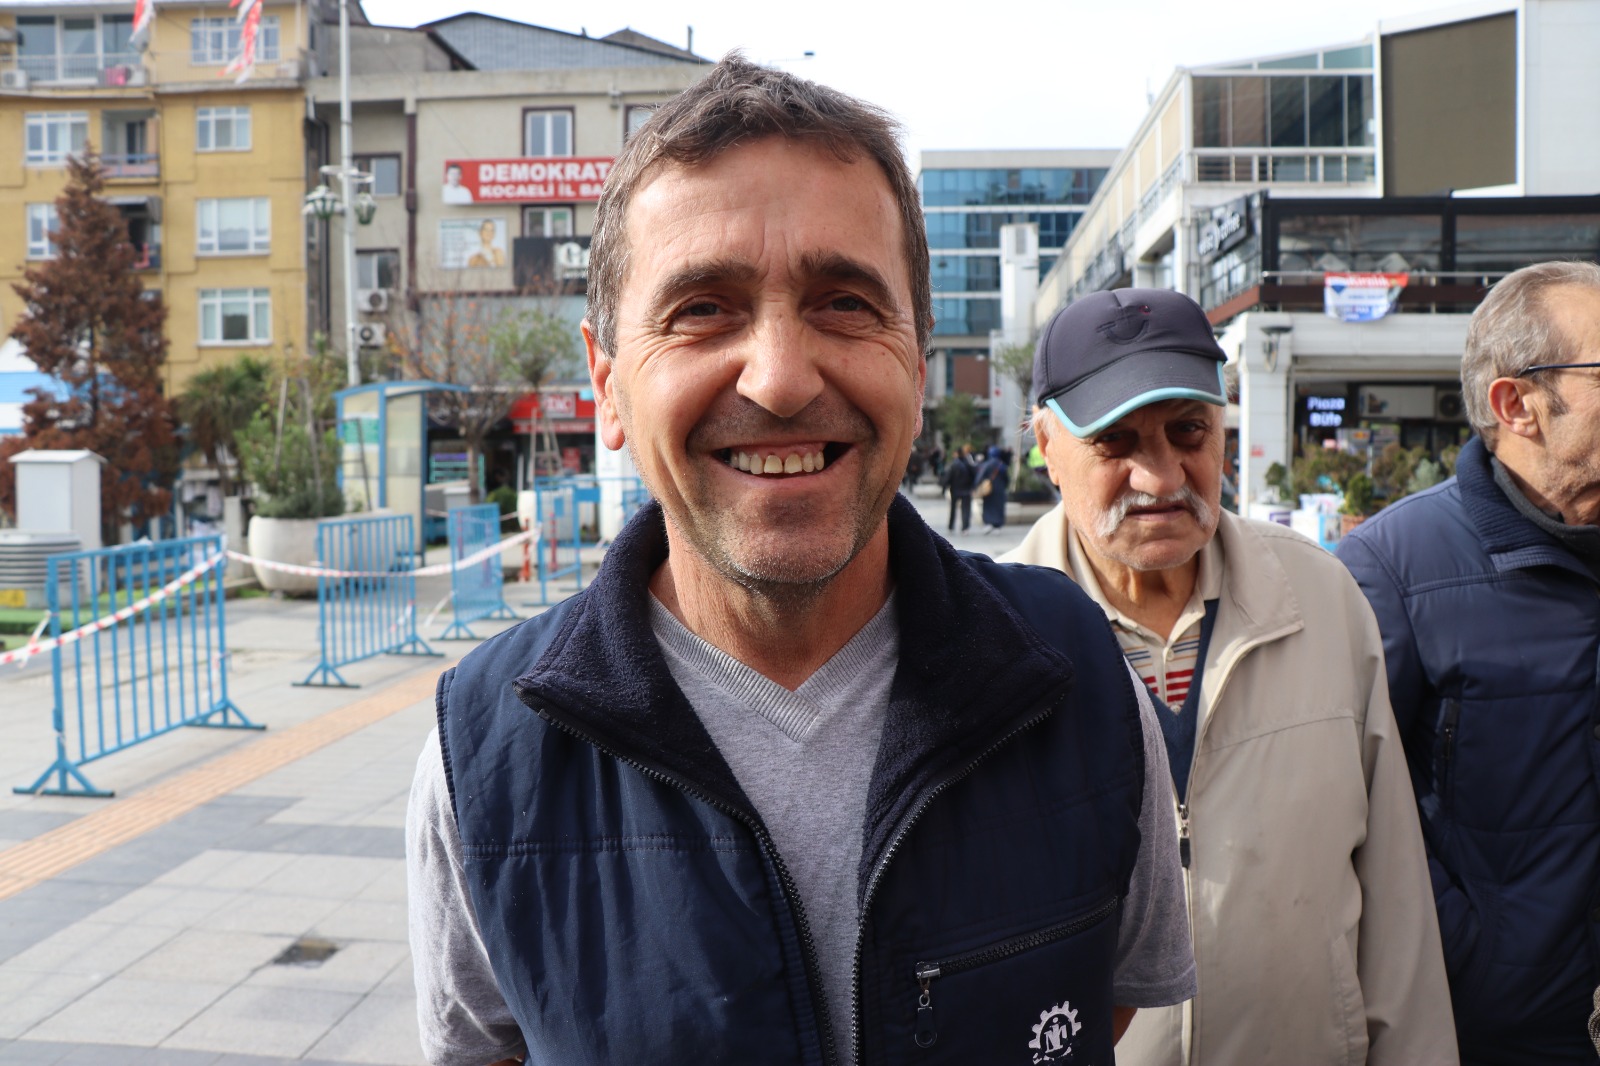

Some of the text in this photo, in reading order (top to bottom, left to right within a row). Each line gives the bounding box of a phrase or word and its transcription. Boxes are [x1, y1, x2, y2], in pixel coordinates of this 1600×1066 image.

[479, 162, 609, 183] DEMOKRAT
[480, 182, 555, 198] KOCAELİ
[558, 183, 577, 197] İL
